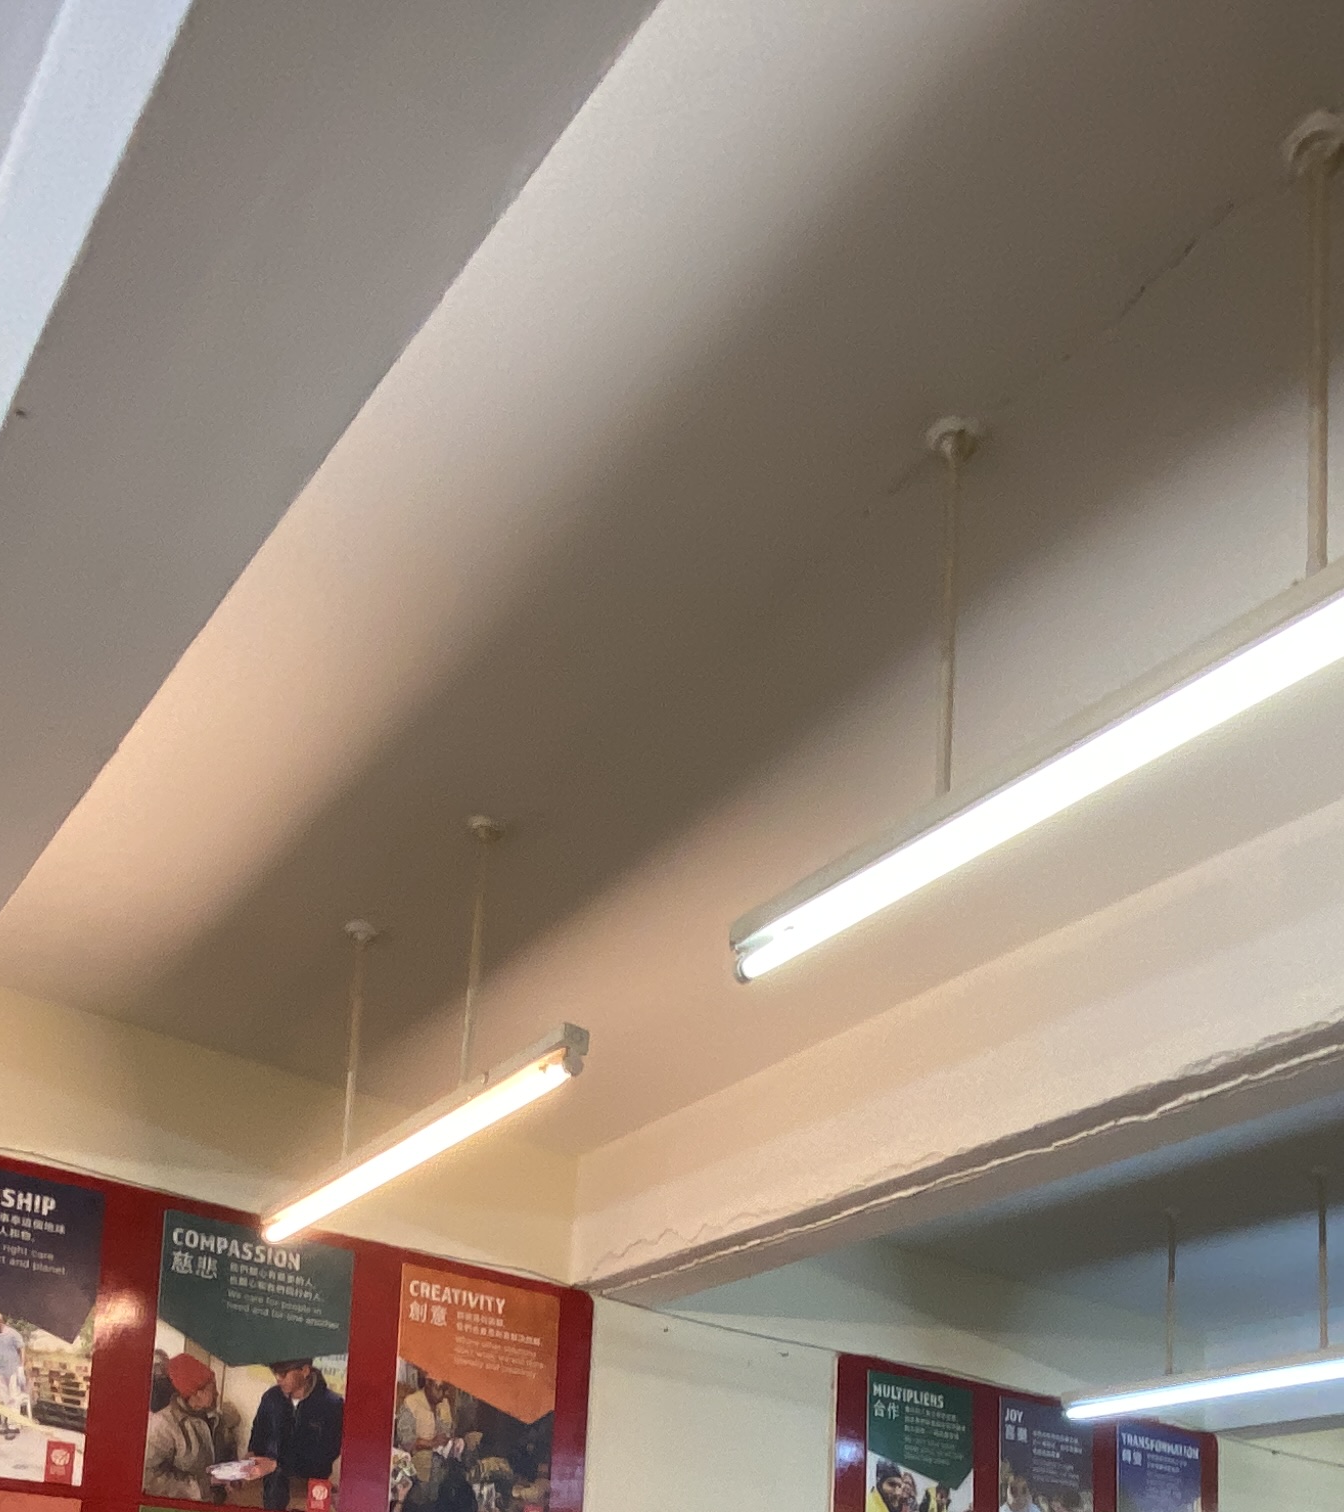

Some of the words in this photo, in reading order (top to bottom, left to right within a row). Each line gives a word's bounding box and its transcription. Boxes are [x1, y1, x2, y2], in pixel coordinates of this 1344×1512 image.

[9, 1257, 30, 1269] and
[172, 1227, 301, 1272] COMPASSION
[171, 1250, 218, 1280] 慈悲
[409, 1279, 506, 1314] CREATIVITY
[409, 1300, 447, 1327] 創意
[872, 1382, 944, 1409] MULTIPLIERS
[873, 1399, 900, 1420] 合作
[1005, 1407, 1024, 1423] JOY
